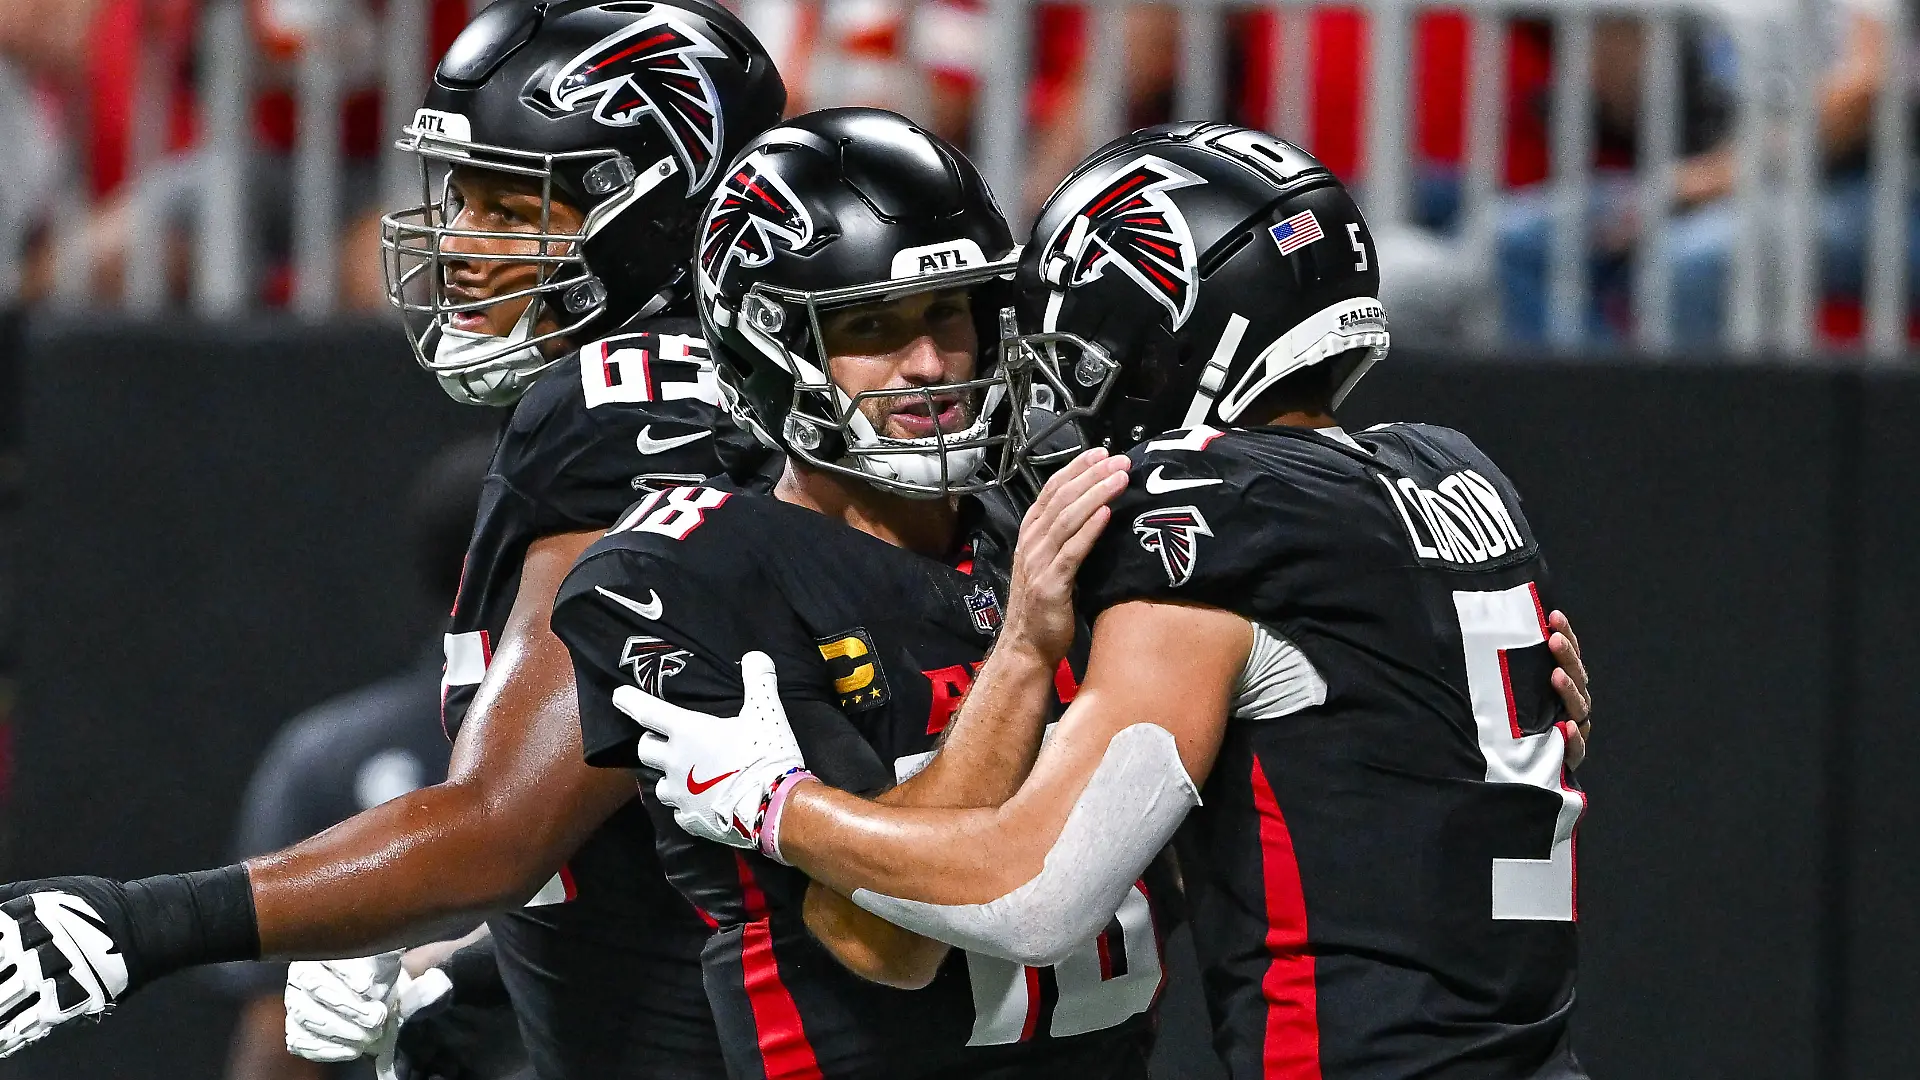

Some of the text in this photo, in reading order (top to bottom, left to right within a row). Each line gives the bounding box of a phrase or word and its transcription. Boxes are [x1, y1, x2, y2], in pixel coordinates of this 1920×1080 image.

[417, 114, 446, 134] ATL
[918, 249, 968, 272] ATL
[1345, 222, 1368, 272] 5
[1339, 306, 1388, 327] FALCON
[603, 486, 733, 541] 18
[1376, 469, 1524, 564] LONDON
[1453, 582, 1588, 922] 5
